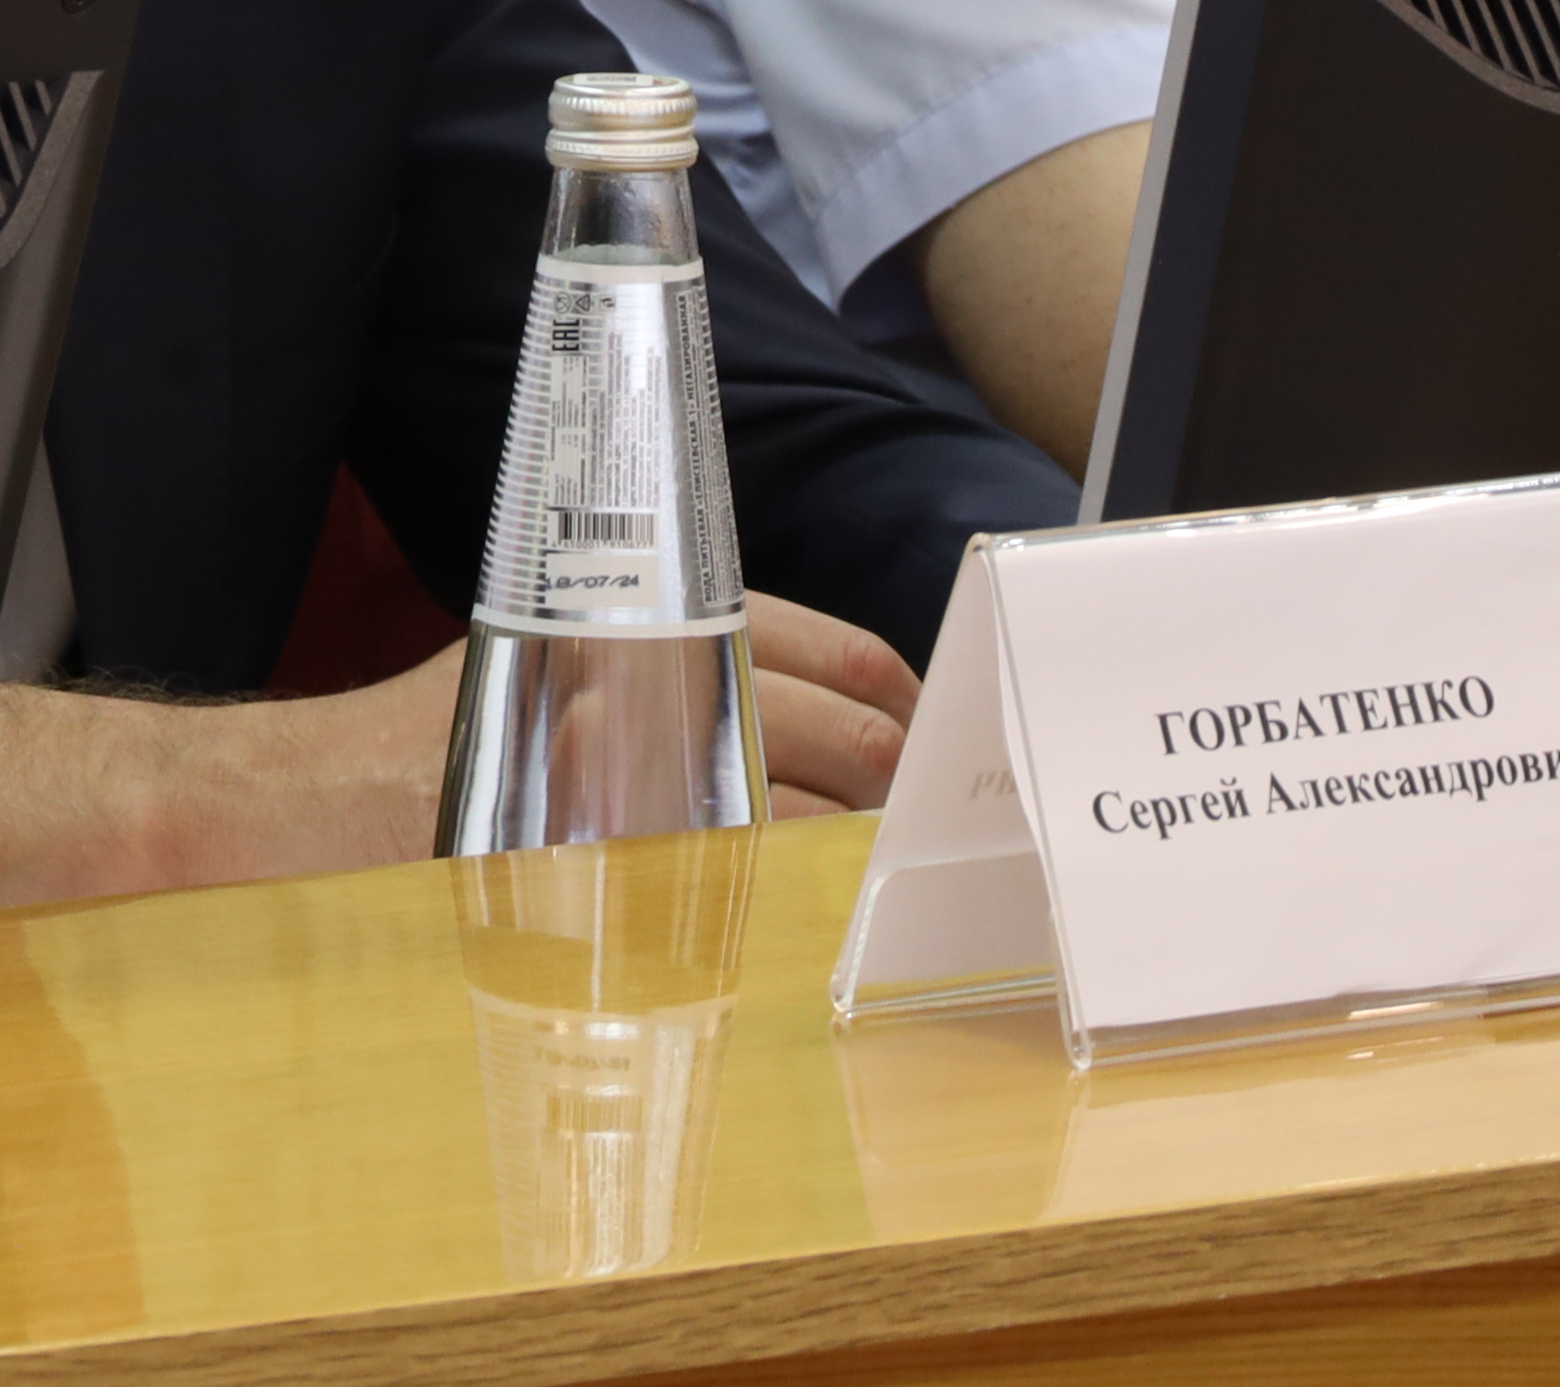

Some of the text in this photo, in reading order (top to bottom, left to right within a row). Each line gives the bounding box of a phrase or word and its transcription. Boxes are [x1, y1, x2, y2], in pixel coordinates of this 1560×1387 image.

[678, 295, 695, 400] НЕГАЗИРОВАННАЯ
[696, 508, 710, 569] ПИТЬЕВАЯ
[702, 573, 714, 603] ВОДА
[1156, 674, 1496, 756] ГОРБАТЕНКО
[1091, 777, 1251, 841] Сергей
